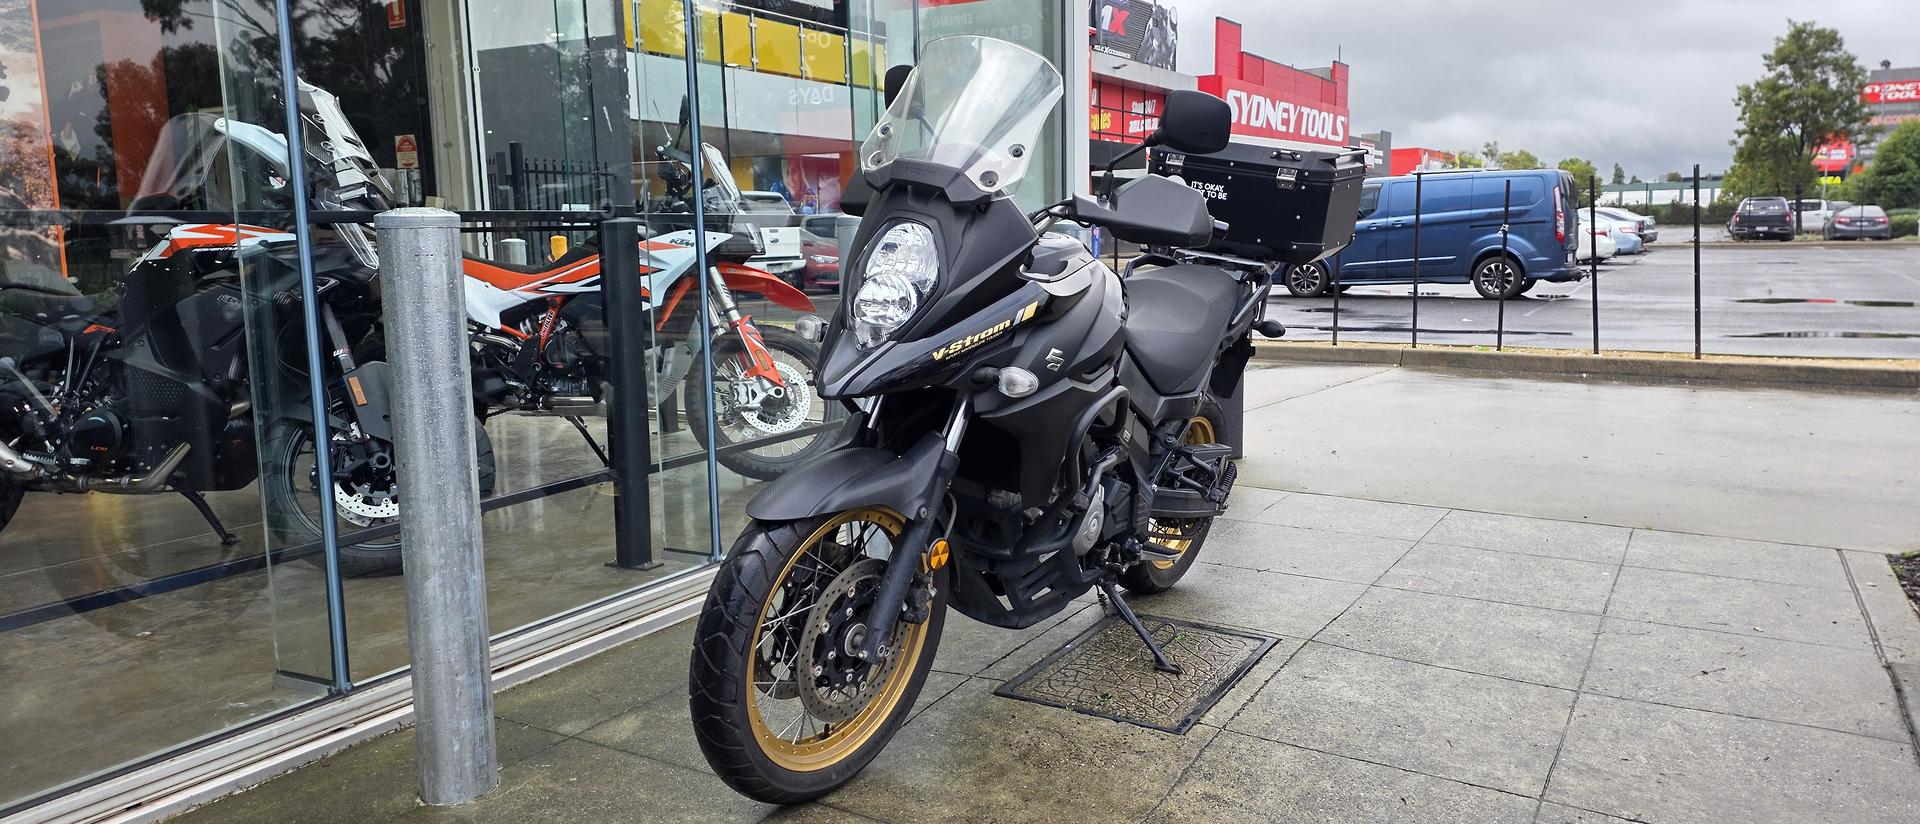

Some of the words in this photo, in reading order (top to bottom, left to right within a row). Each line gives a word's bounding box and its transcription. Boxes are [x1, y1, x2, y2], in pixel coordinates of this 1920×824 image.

[1227, 89, 1300, 133] SYDNEY
[1301, 106, 1345, 142] TOOLS
[1191, 181, 1203, 190] IT'S
[1207, 190, 1217, 198] TO
[1217, 192, 1228, 200] BE
[669, 238, 695, 247] KTM
[932, 319, 1011, 361] V-Strom
